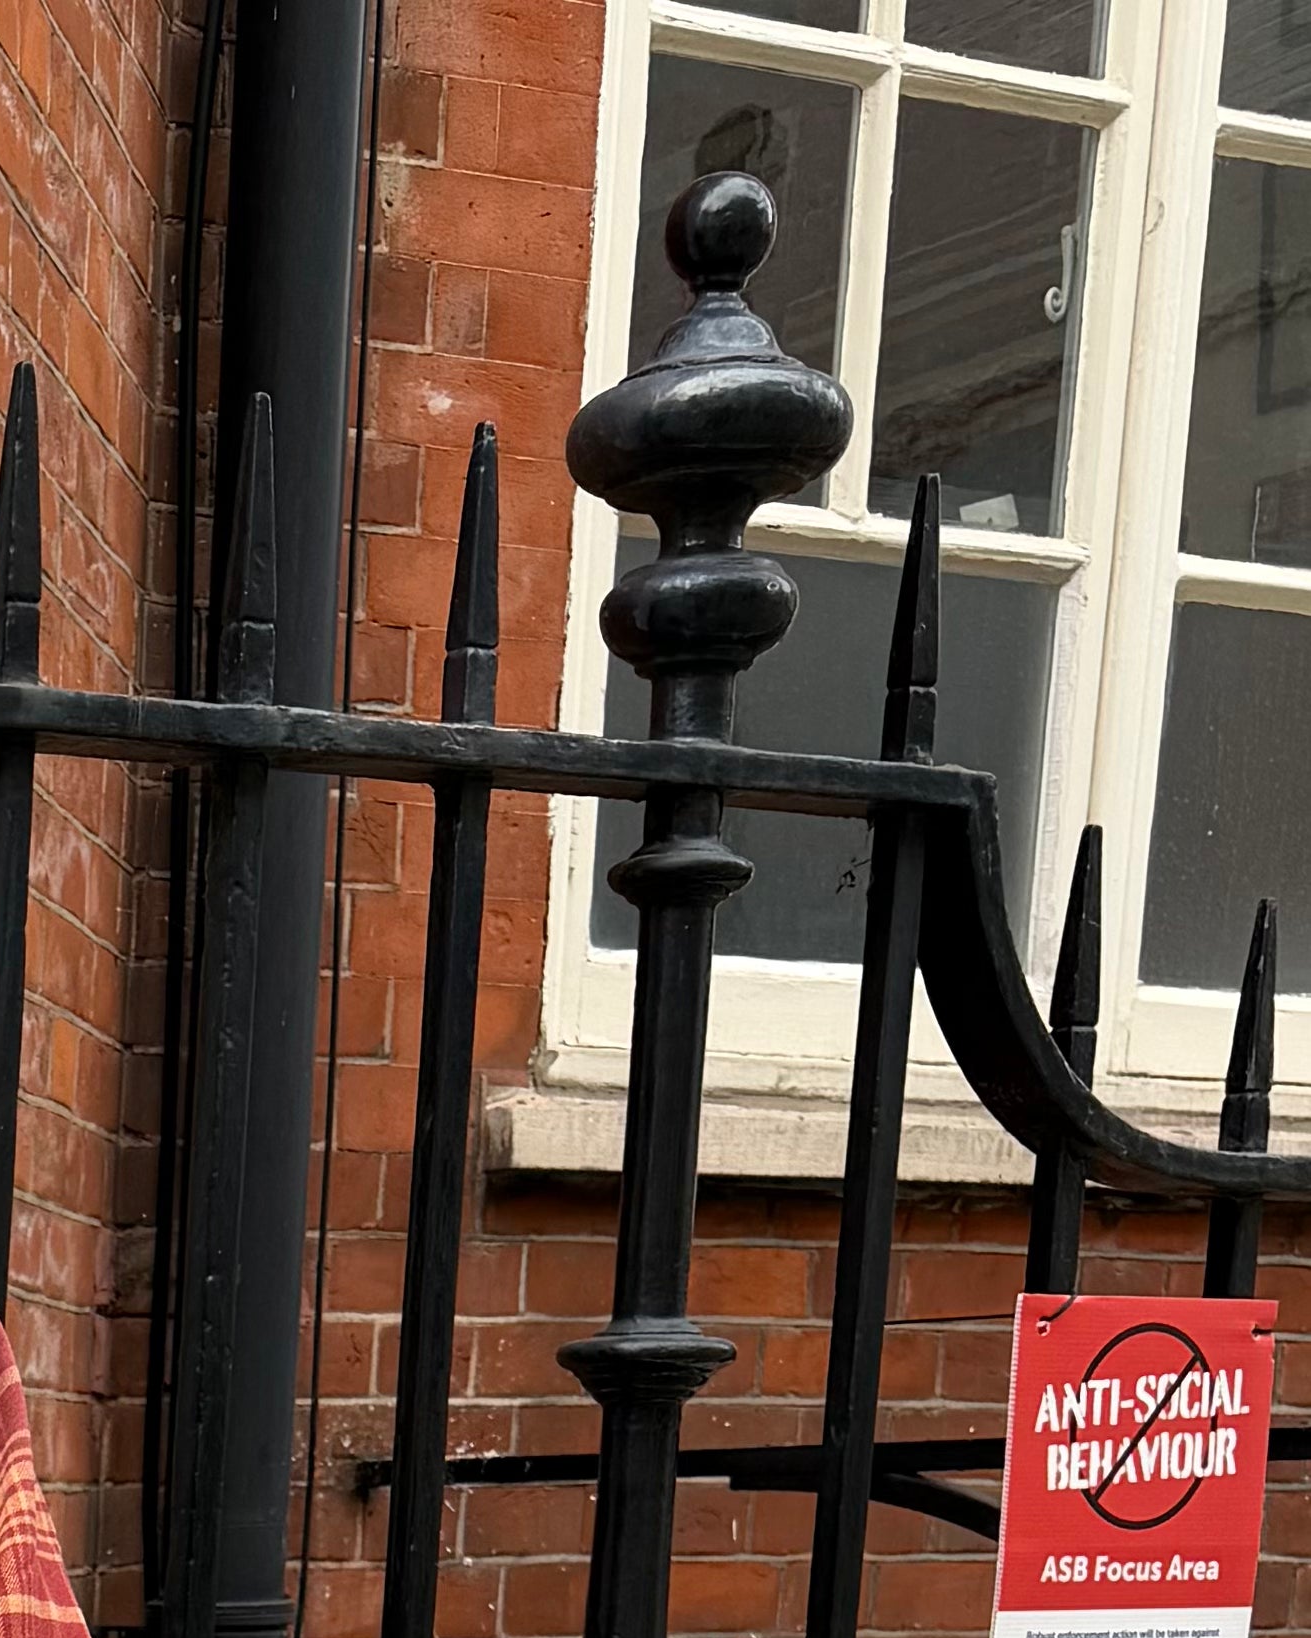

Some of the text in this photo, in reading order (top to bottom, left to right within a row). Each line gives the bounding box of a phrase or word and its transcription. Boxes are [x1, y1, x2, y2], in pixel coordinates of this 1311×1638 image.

[1034, 1368, 1250, 1433] ANTI-SOCIAL
[1047, 1427, 1237, 1491] BEHAVIOUR
[1040, 1554, 1219, 1582] ASB Focus Area
[1112, 1630, 1137, 1638] action
[1139, 1629, 1153, 1638] will
[1156, 1629, 1165, 1638] be
[1167, 1629, 1189, 1638] taken
[1191, 1629, 1219, 1638] against
